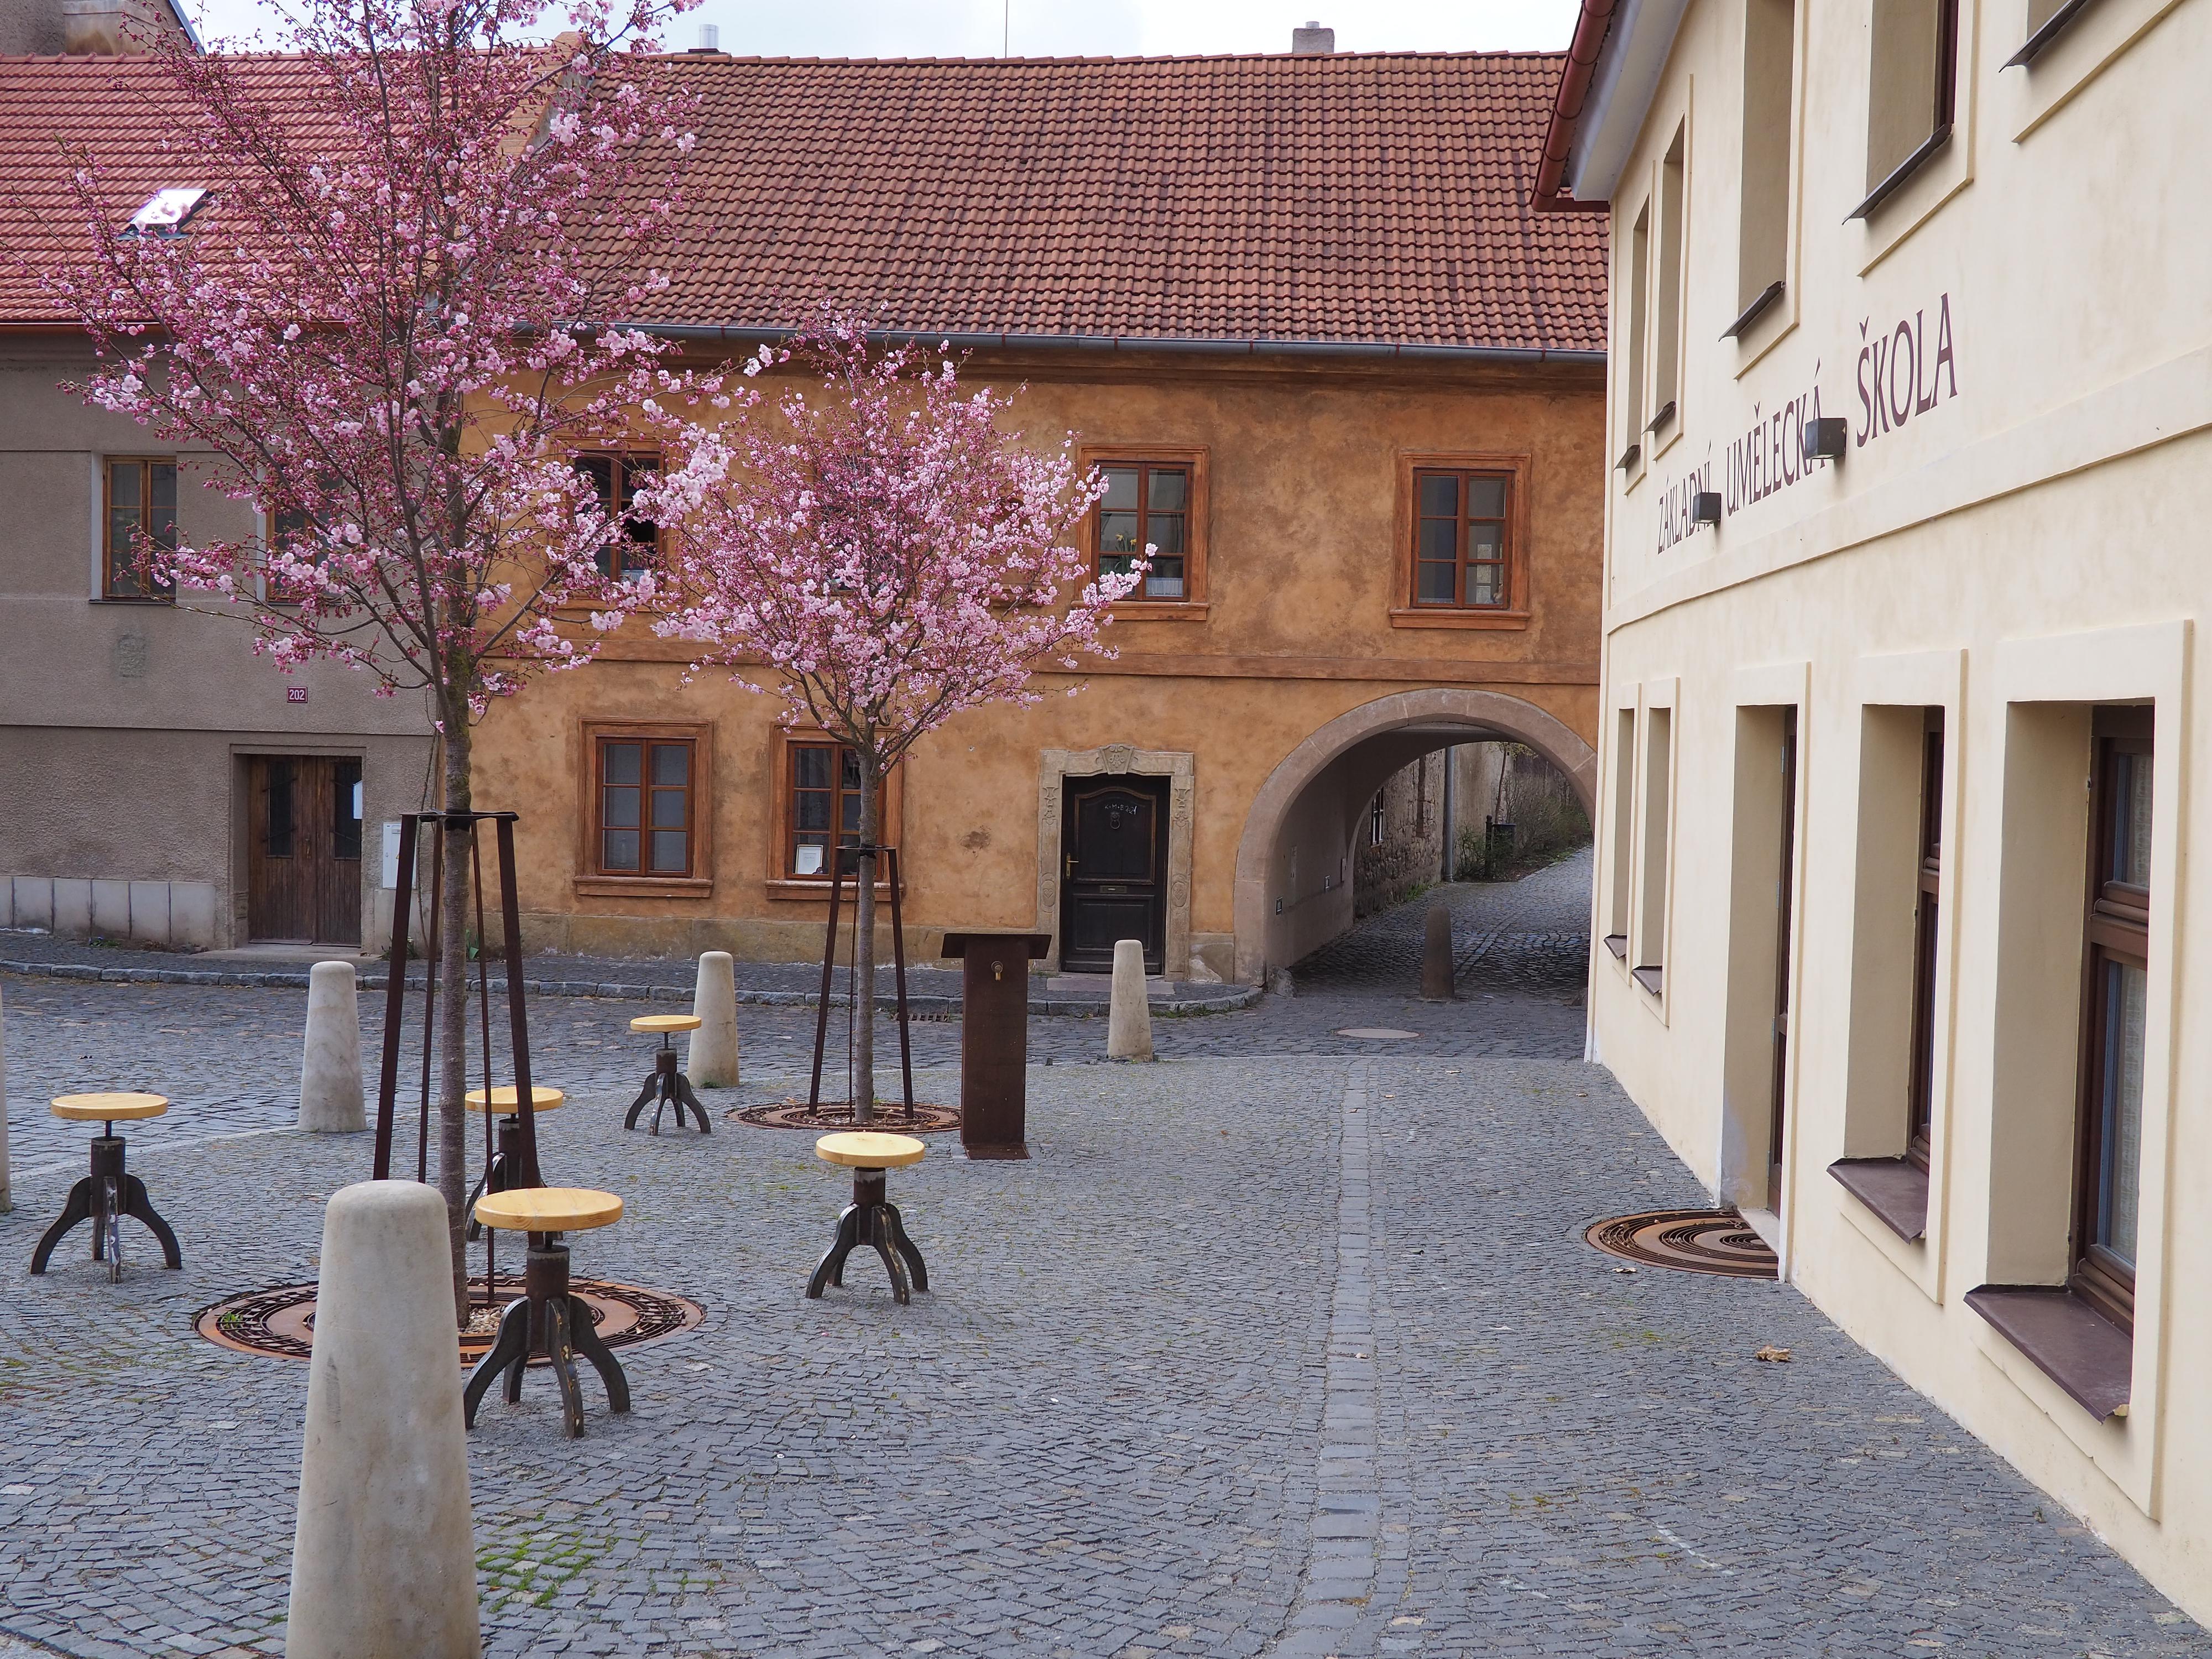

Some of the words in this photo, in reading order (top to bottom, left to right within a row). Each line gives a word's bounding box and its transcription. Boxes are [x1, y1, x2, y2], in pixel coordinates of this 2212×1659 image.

[1726, 356, 1826, 517] UMĚLECKÁ
[1856, 292, 1958, 448] ŠKOLA
[289, 689, 305, 700] 202
